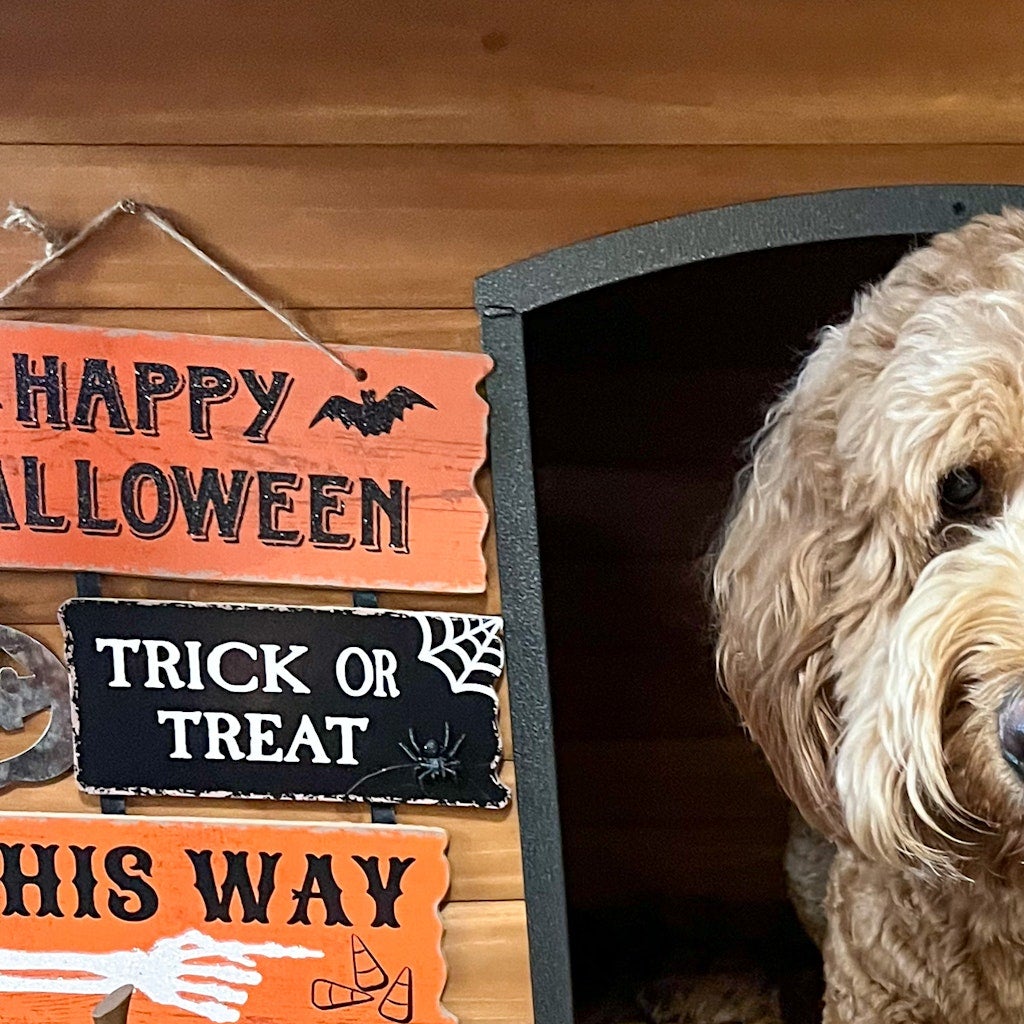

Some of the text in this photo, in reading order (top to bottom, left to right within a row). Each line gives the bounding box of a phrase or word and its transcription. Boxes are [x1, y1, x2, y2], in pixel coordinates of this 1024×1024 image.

[12, 352, 294, 443] HAPPY
[95, 637, 401, 698] TRICK OR
[157, 709, 370, 766] TREAT
[185, 848, 416, 928] WAY
